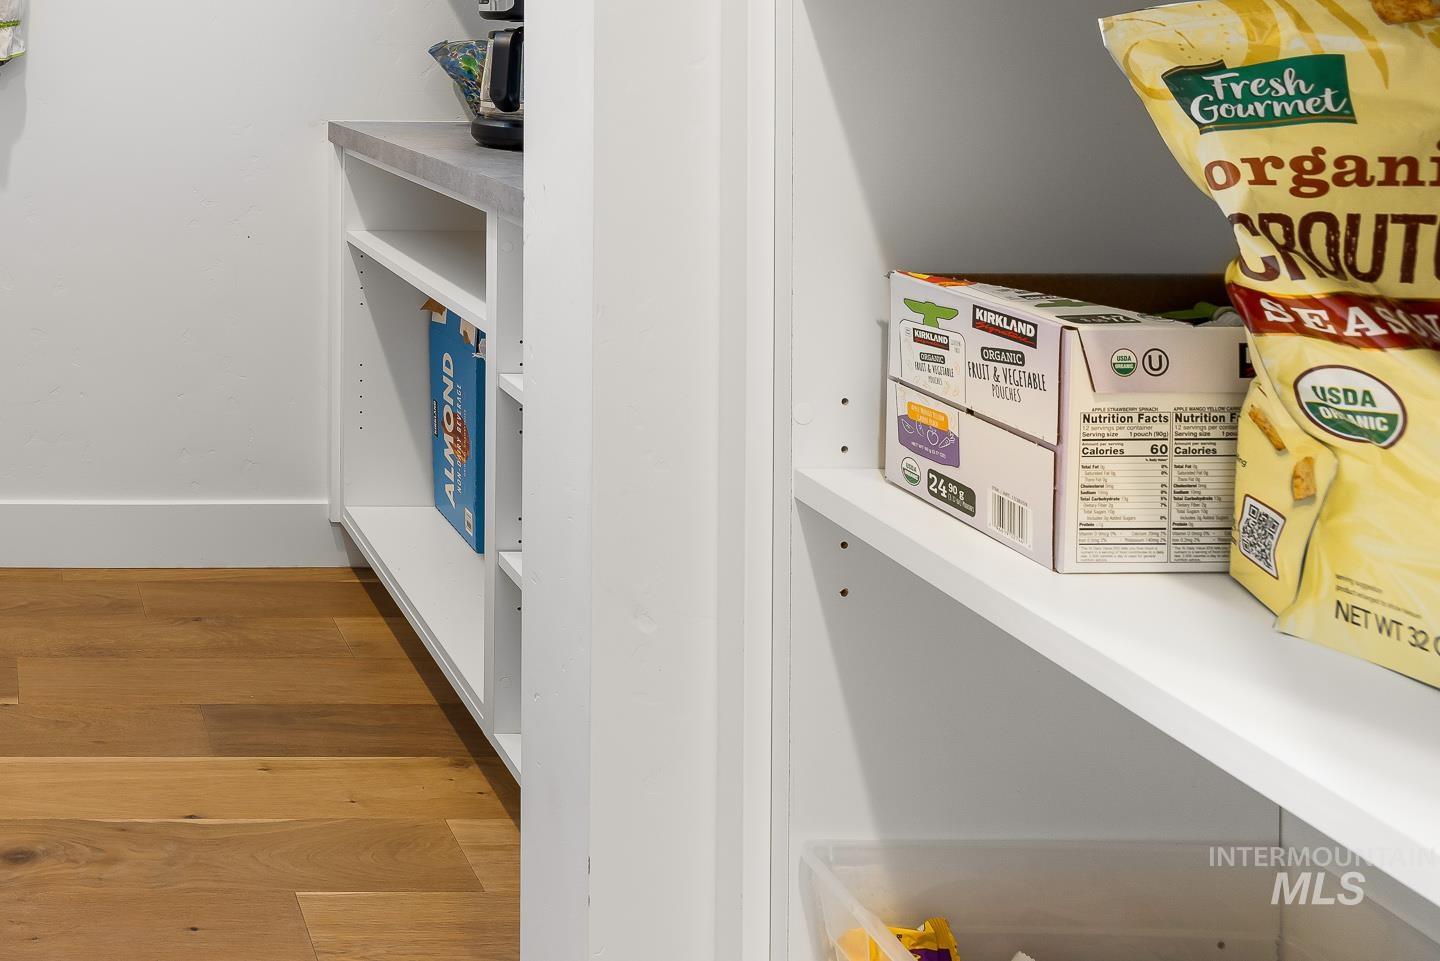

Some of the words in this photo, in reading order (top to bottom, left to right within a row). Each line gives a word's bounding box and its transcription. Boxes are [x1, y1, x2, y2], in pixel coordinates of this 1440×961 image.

[1201, 66, 1315, 102] Fresh
[1190, 86, 1348, 124] Gourmet
[1204, 145, 1440, 199] organi
[1227, 211, 1440, 284] CROUT
[975, 308, 1036, 338] KIRKLAND
[914, 329, 948, 345] KIRKLAND
[920, 353, 944, 363] ORGANIC
[983, 349, 1023, 365] ORGANIC
[914, 362, 927, 371] FRUIT
[932, 365, 954, 378] VEGETABLE
[968, 362, 991, 381] FRUIT
[992, 366, 1000, 383] &
[1002, 366, 1047, 391] VEGETABLE
[991, 384, 1022, 403] POUCHES
[1311, 385, 1377, 408] USDA
[1083, 414, 1133, 423] Nutrition
[1138, 414, 1169, 423] Facts
[1175, 413, 1225, 423] Nutrition
[442, 352, 456, 509] ALMOND
[1082, 447, 1124, 455] Calories
[1150, 444, 1169, 454] 60
[928, 472, 947, 498] 24
[948, 483, 958, 494] 90
[1335, 599, 1371, 629] NET
[1374, 613, 1403, 641] WT
[1408, 626, 1430, 651] 32
